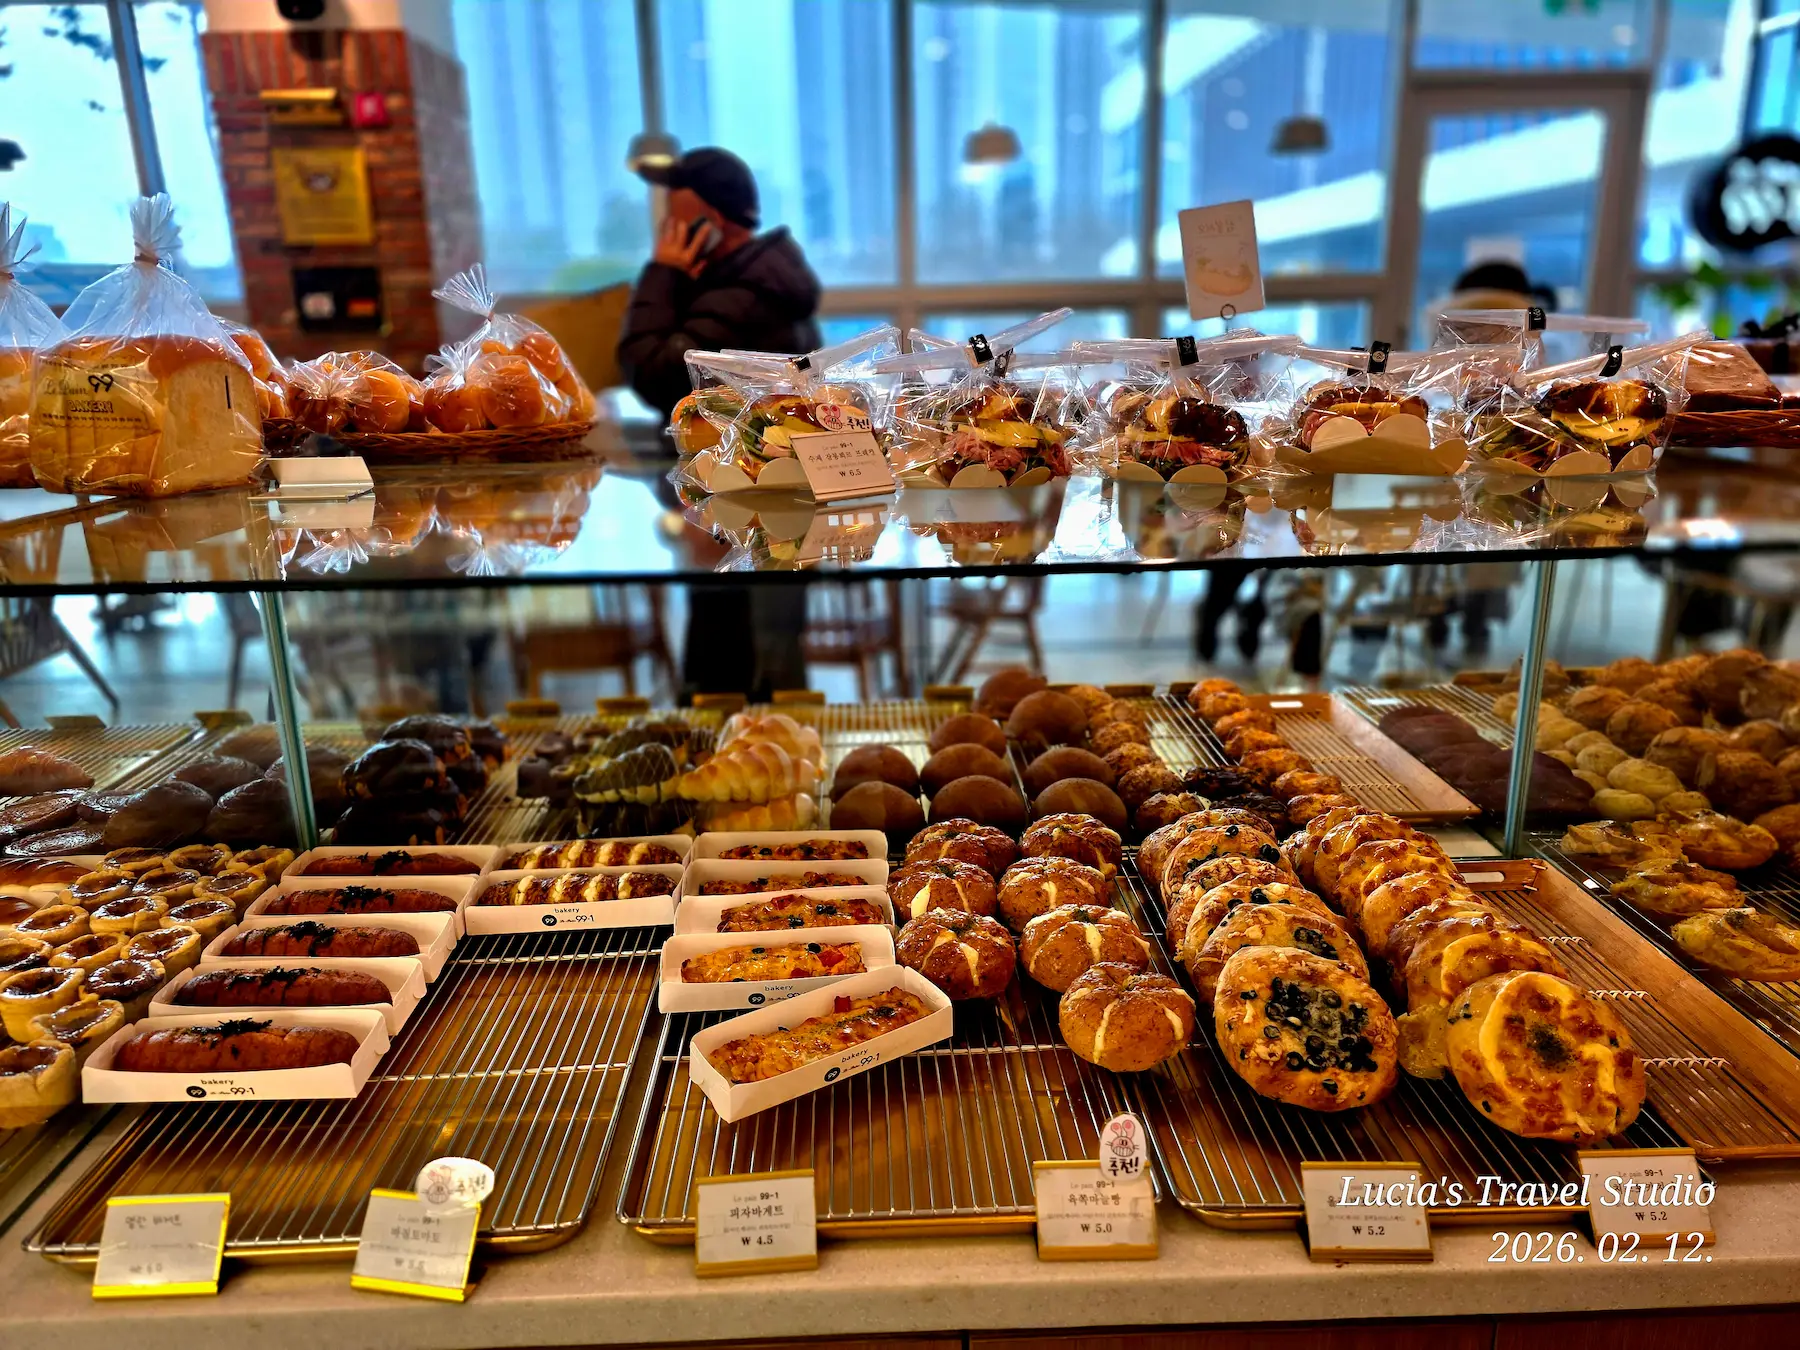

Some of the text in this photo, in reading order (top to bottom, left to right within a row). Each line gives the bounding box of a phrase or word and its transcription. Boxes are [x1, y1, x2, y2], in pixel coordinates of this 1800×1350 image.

[87, 373, 114, 393] 99
[849, 468, 862, 476] 6.5
[841, 1048, 869, 1063] bakery
[1108, 1157, 1139, 1177] 추천!
[1644, 1169, 1663, 1177] 99-1
[1096, 1180, 1115, 1188] 99-1
[760, 1191, 779, 1200] 99-1
[729, 1204, 784, 1219] 피자바게트
[1650, 1211, 1668, 1221] 5.2
[1096, 1223, 1112, 1233] 5.0
[1367, 1226, 1385, 1236] 5.2
[756, 1235, 773, 1245] 4.5
